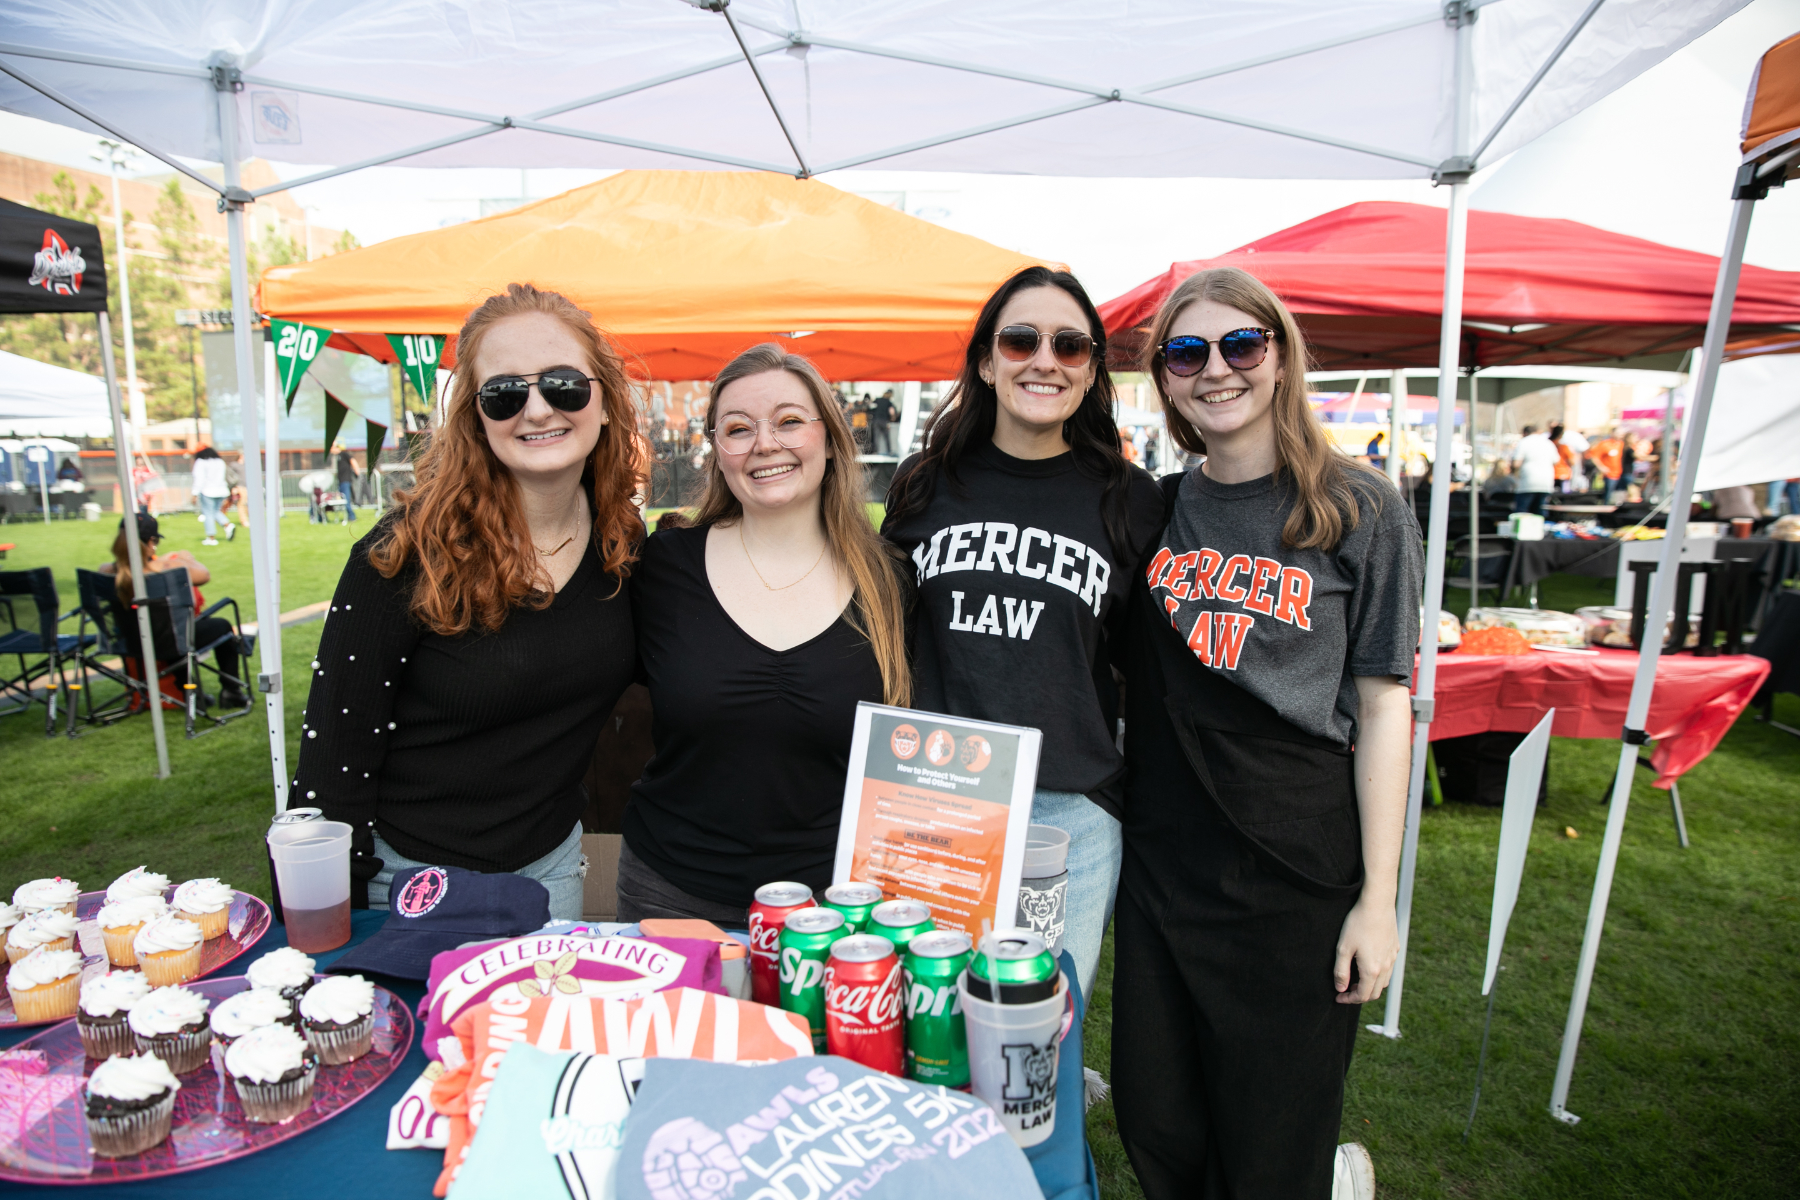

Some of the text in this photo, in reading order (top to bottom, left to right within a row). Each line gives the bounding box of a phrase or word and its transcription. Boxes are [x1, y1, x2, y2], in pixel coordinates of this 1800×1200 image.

[277, 325, 318, 361] 20
[403, 335, 437, 366] 10
[912, 522, 1110, 617] MERCER
[1146, 547, 1313, 631] MERCER
[949, 591, 1045, 640] LAW
[897, 763, 913, 774] How
[922, 768, 949, 780] Protect
[949, 773, 980, 786] Yourself
[917, 775, 956, 790] and Others
[899, 791, 914, 799] Know
[929, 797, 950, 806] Viruses
[952, 802, 972, 811] Spread
[931, 837, 949, 845] BEAR
[460, 938, 668, 985] CELEBRATING
[840, 1025, 879, 1036] ORIGINAL
[903, 1085, 976, 1130] 5K
[1021, 1107, 1053, 1130] LAW
[741, 1072, 910, 1178] LAUREN
